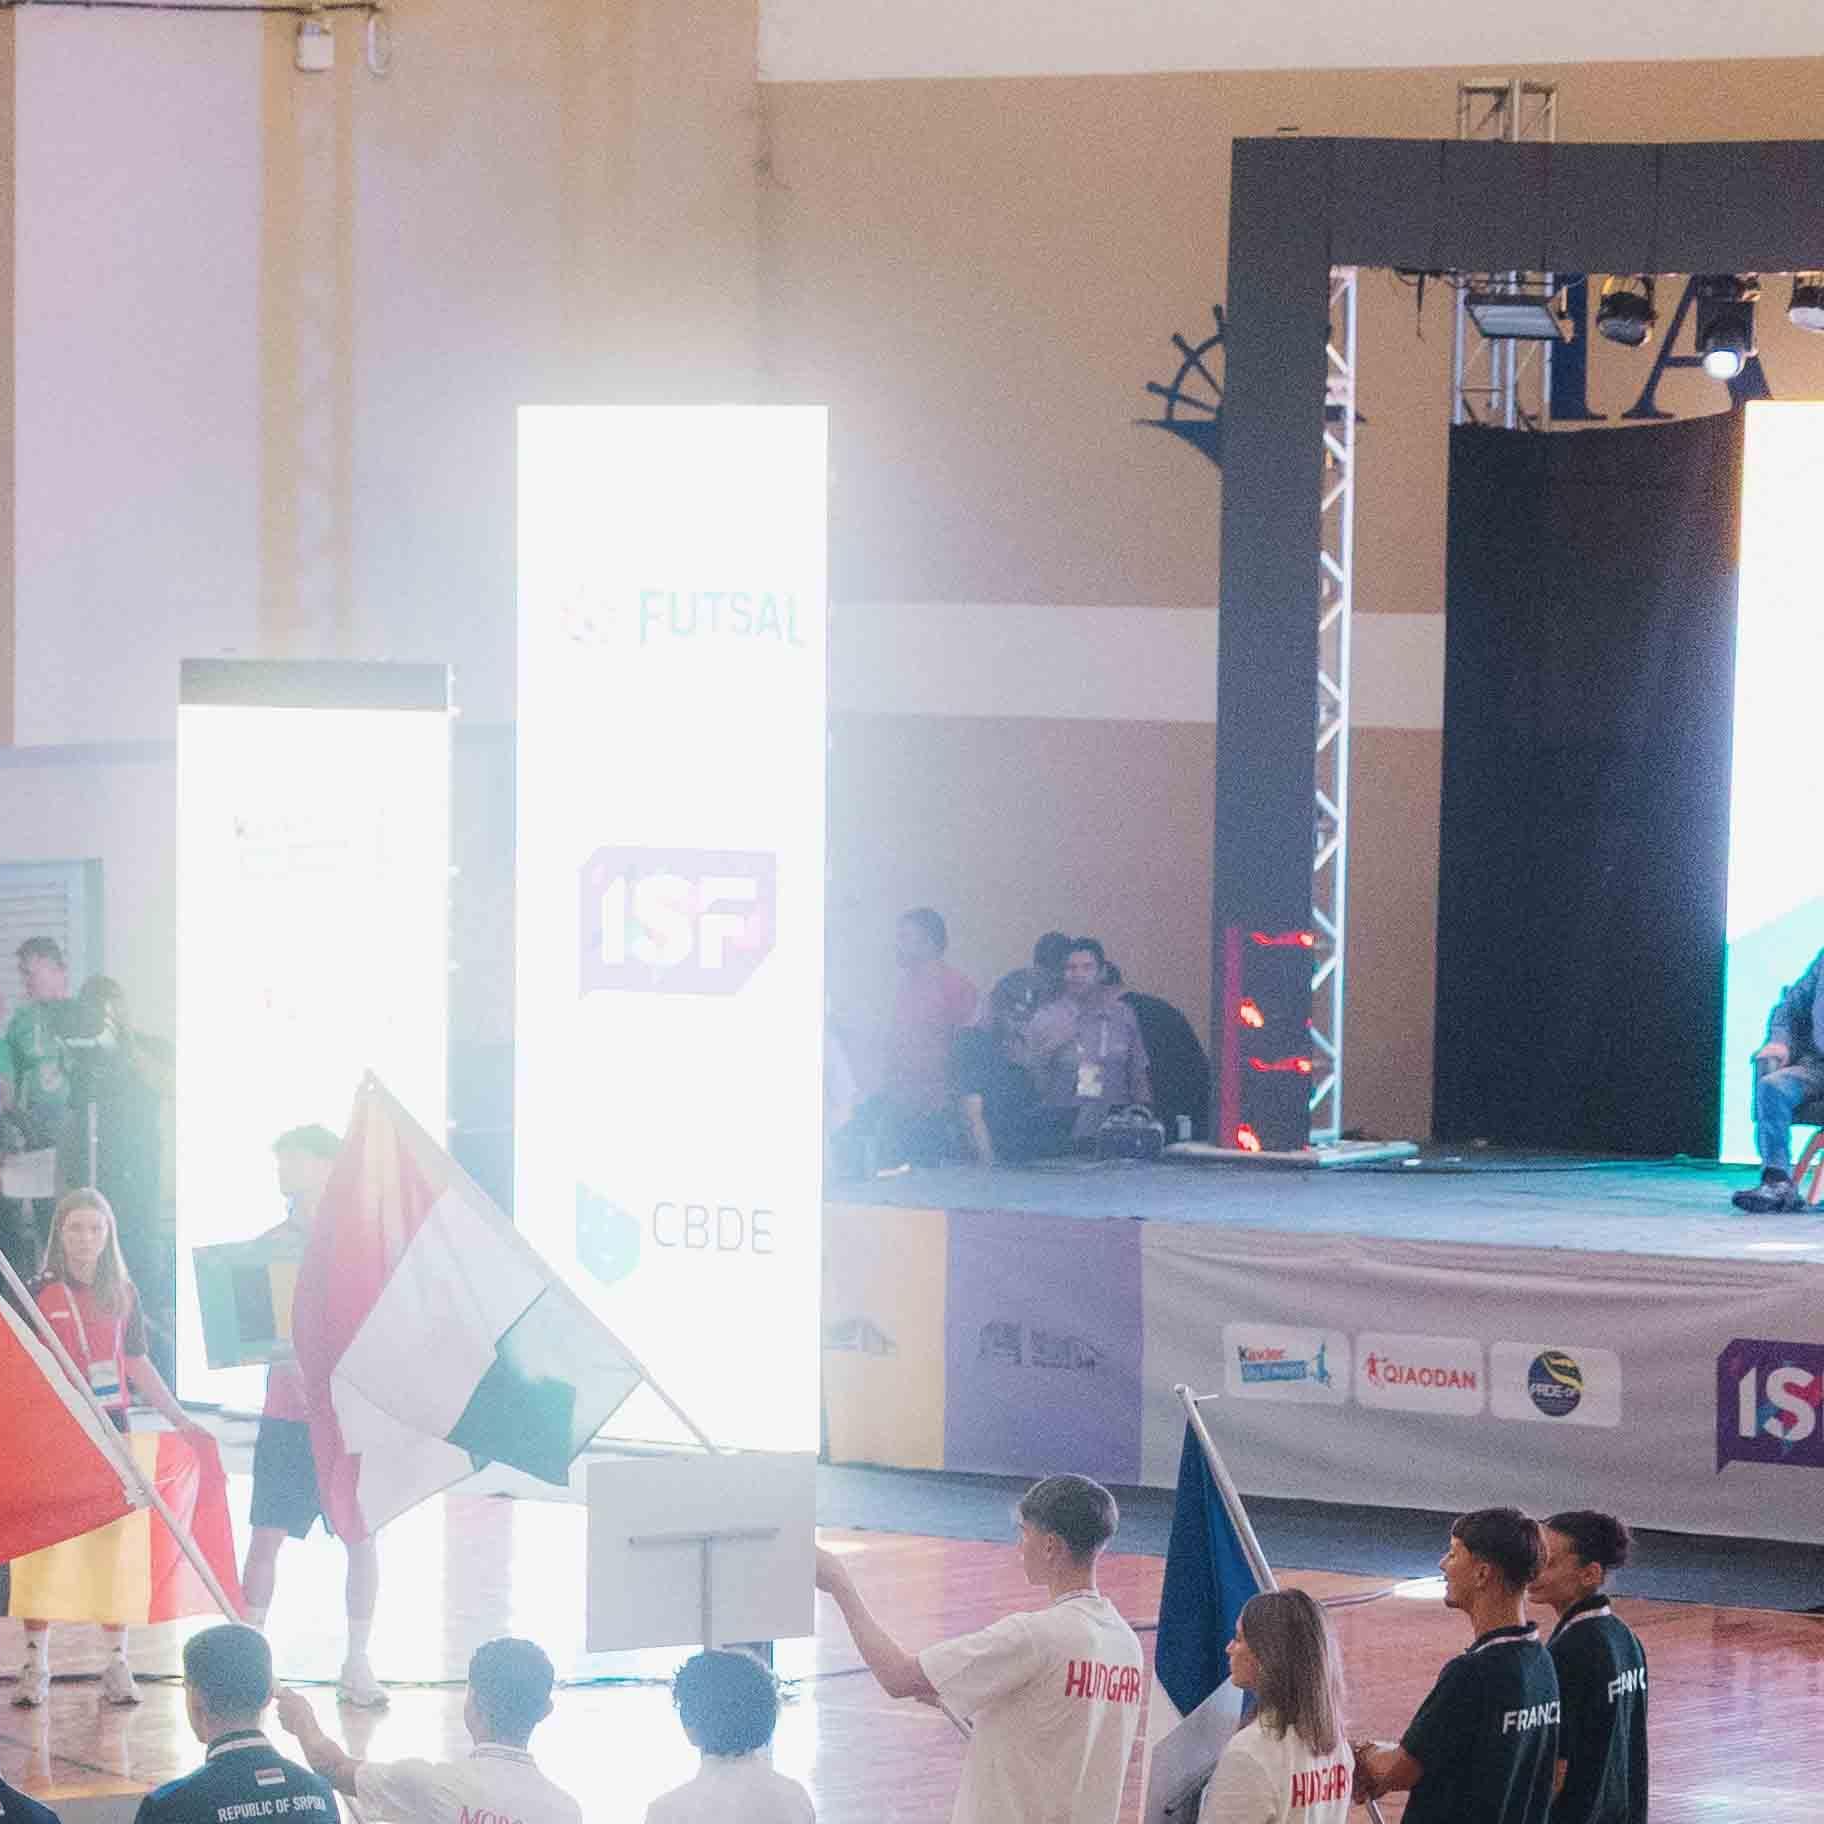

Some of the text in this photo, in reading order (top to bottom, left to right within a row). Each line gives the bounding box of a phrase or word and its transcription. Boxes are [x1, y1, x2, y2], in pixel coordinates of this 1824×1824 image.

[638, 588, 805, 648] FUTSAL
[601, 873, 762, 971] ISF
[651, 1201, 776, 1256] CBDE
[1383, 1363, 1477, 1391] QIAODAN
[217, 1799, 273, 1823] REPUBLIC
[275, 1798, 291, 1815] OF
[1291, 1763, 1349, 1809] HUNGAR
